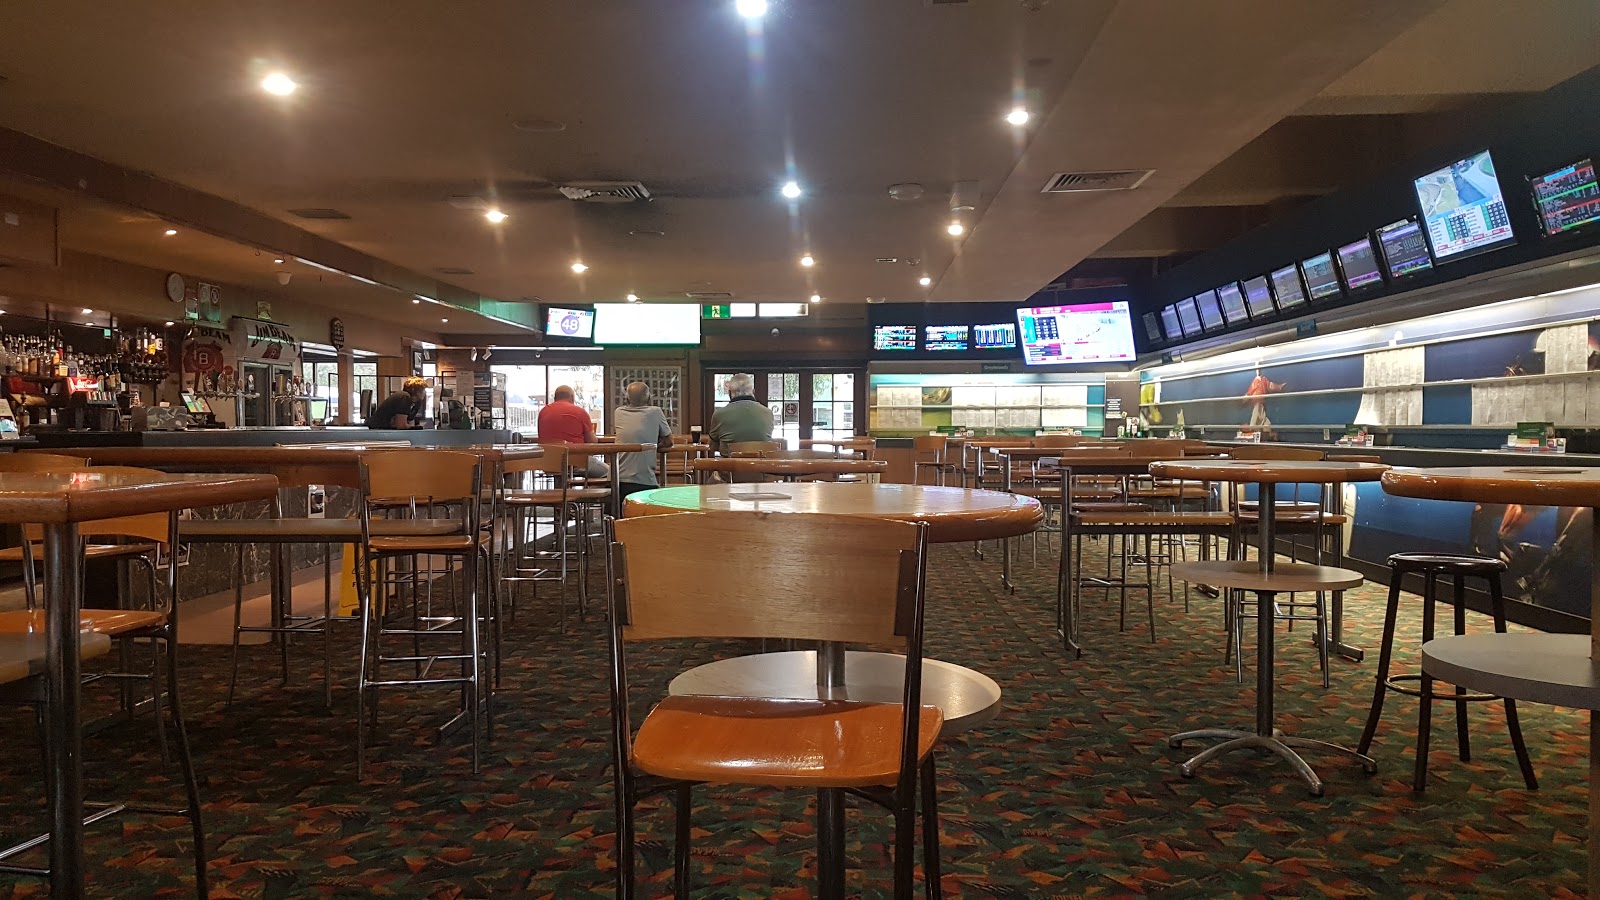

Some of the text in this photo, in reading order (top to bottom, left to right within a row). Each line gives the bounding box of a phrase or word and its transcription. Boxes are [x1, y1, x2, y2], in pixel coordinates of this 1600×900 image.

[562, 319, 578, 331] 48
[267, 324, 296, 352] BEAM
[199, 352, 208, 365] B
